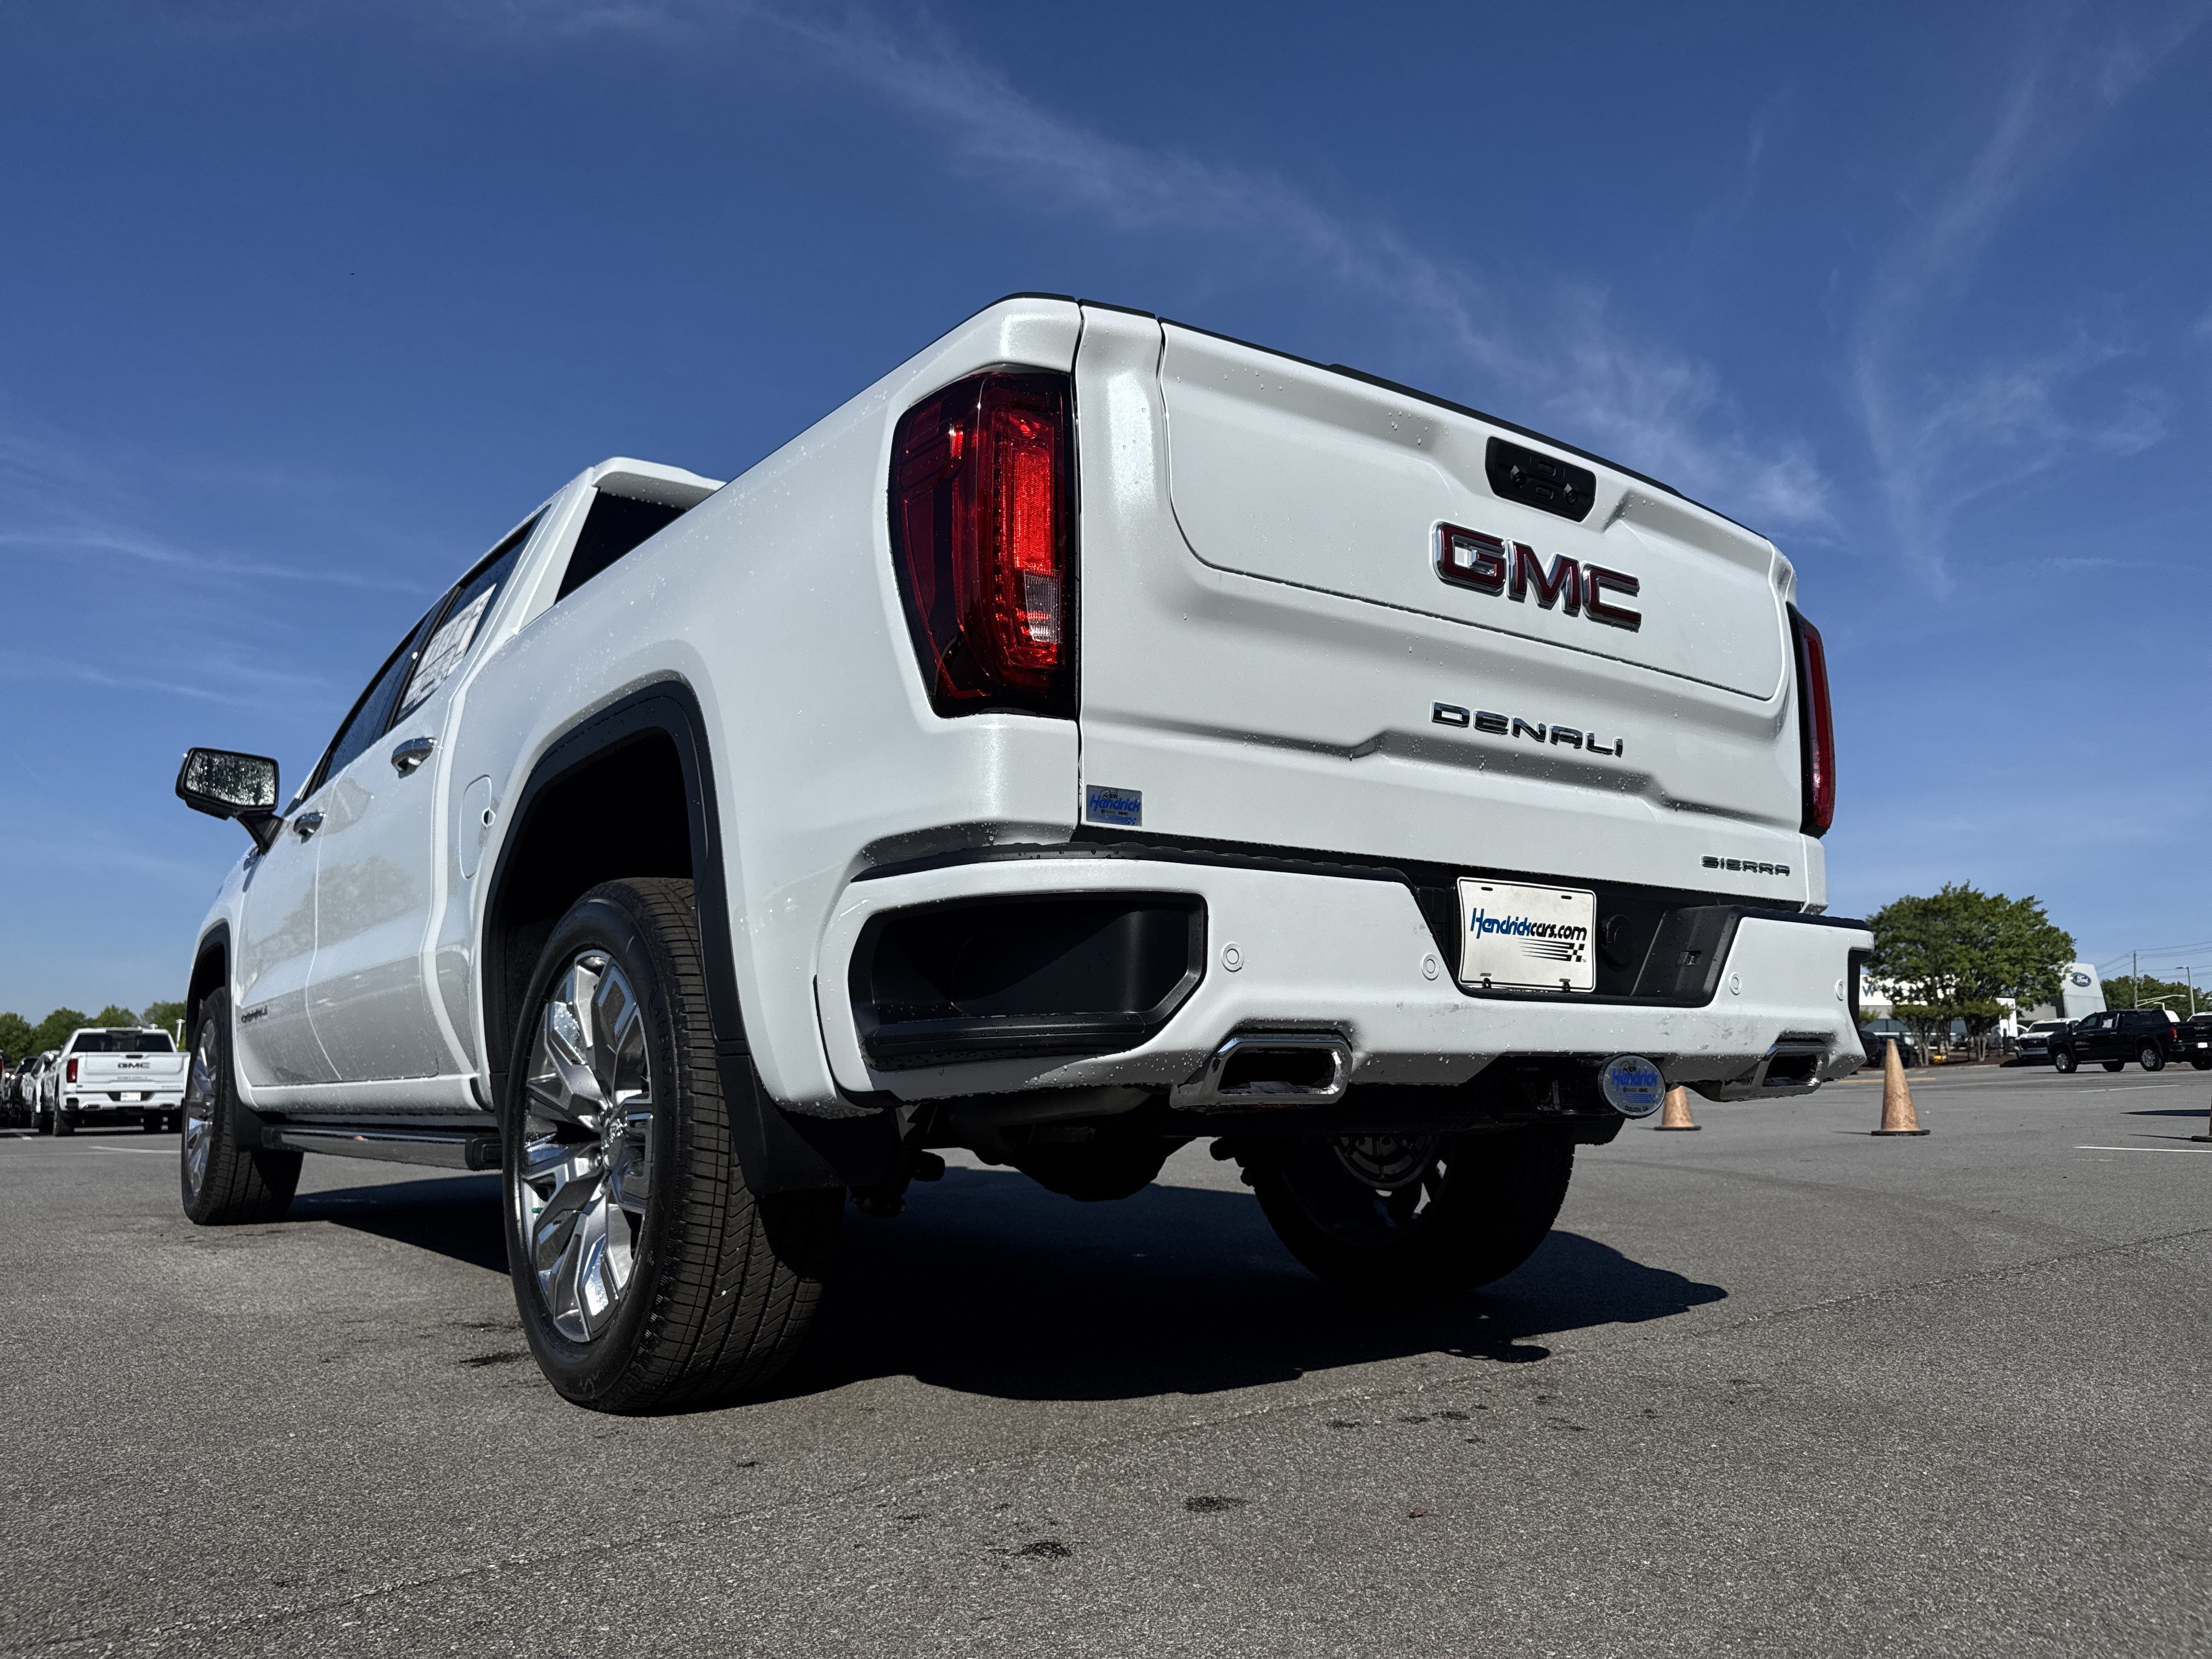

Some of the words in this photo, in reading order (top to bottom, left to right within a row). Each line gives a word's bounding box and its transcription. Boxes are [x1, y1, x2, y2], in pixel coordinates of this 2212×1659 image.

[1432, 521, 1642, 632] GMC
[1431, 701, 1623, 758] DENALI
[1090, 794, 1141, 812] Hendrick
[1100, 789, 1118, 802] Rick
[1701, 855, 1790, 877] SIERRA
[1470, 907, 1587, 941] Hendrickcars.com
[1620, 1059, 1638, 1076] Rick
[1611, 1068, 1658, 1091] Hendrick
